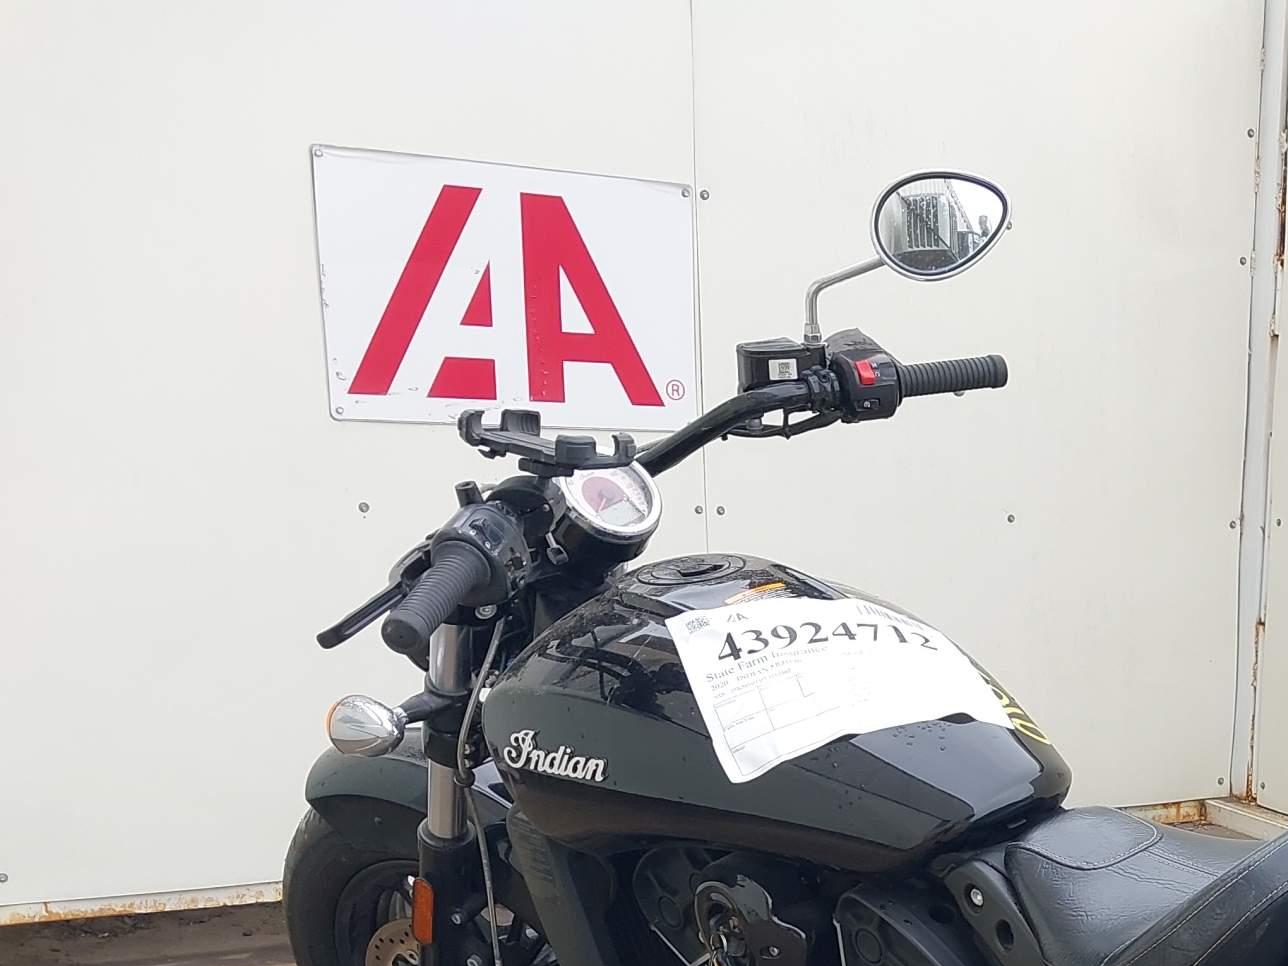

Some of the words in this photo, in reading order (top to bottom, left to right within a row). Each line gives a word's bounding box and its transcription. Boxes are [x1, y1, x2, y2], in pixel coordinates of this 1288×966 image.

[717, 621, 938, 661] 43924712
[705, 667, 735, 681] State
[737, 655, 768, 671] Farm
[503, 729, 605, 782] Indian
